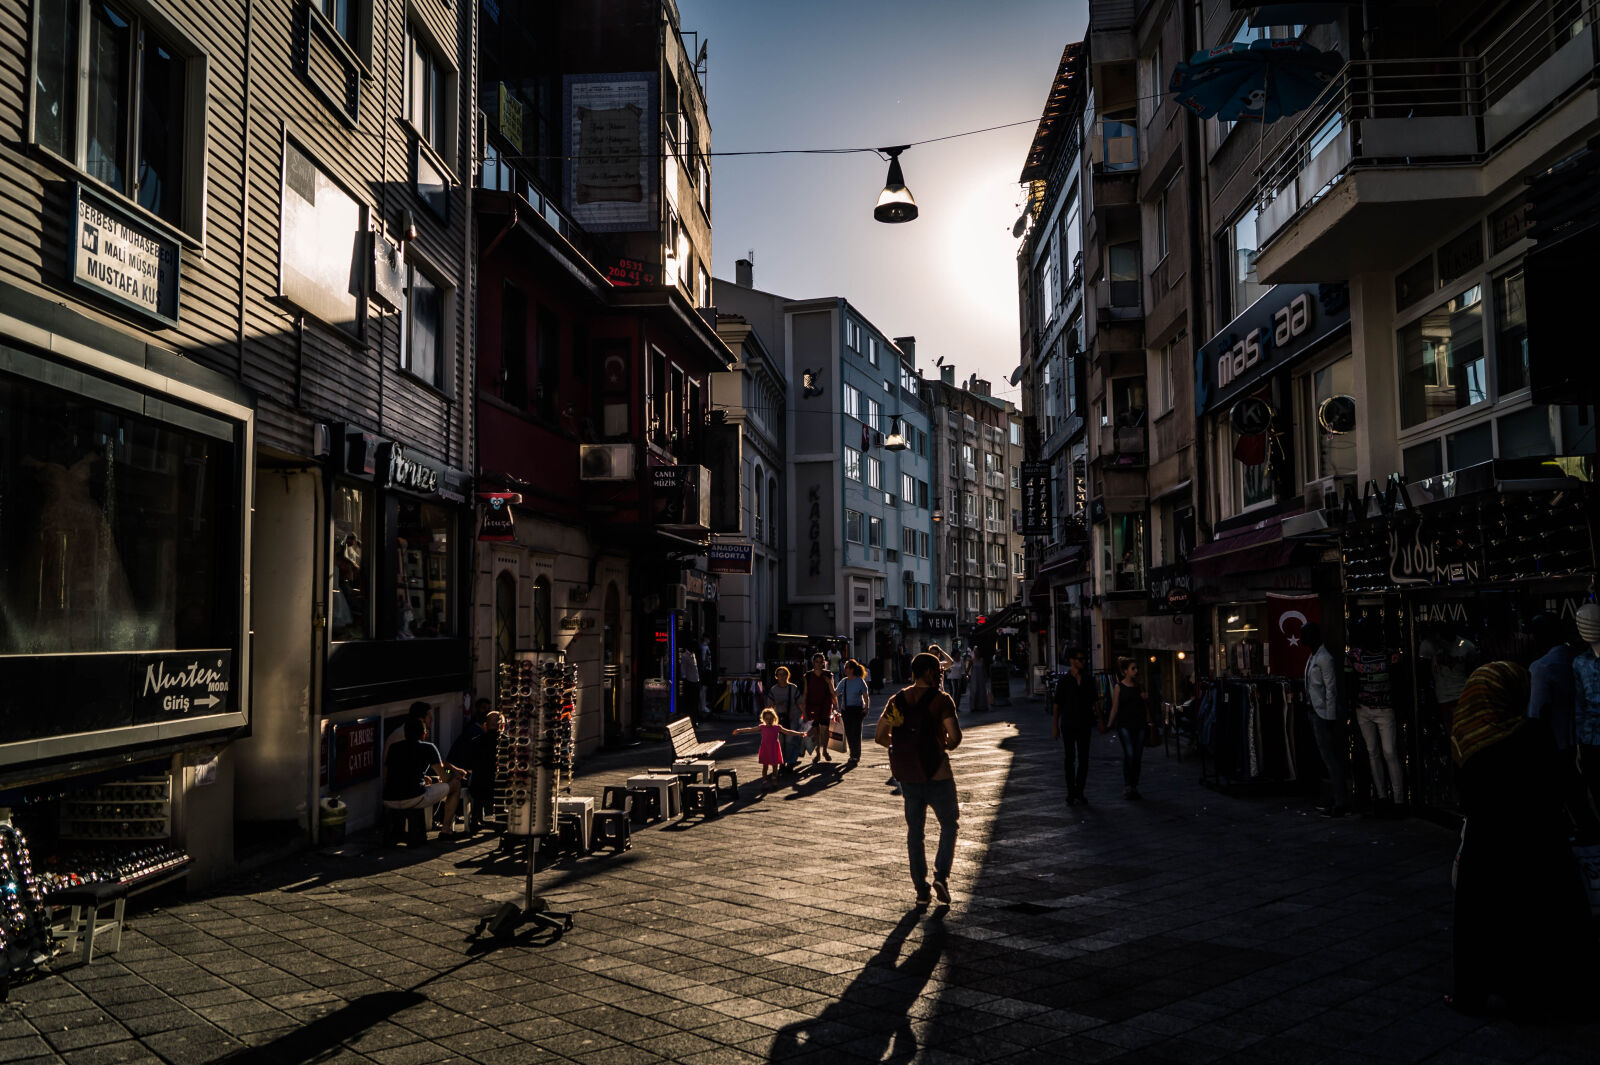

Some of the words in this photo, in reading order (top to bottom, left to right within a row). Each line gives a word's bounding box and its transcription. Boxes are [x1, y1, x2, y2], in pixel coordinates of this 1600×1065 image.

[79, 202, 120, 236] SERBEST
[104, 240, 126, 264] MALİ
[87, 257, 139, 299] MUSTAFA
[608, 266, 626, 279] 200
[711, 545, 751, 553] ANADOLU
[1436, 560, 1479, 585] MEN
[928, 618, 954, 629] VENA
[143, 660, 222, 697] Nurten
[208, 681, 229, 692] MODA
[163, 694, 190, 713] Giriş
